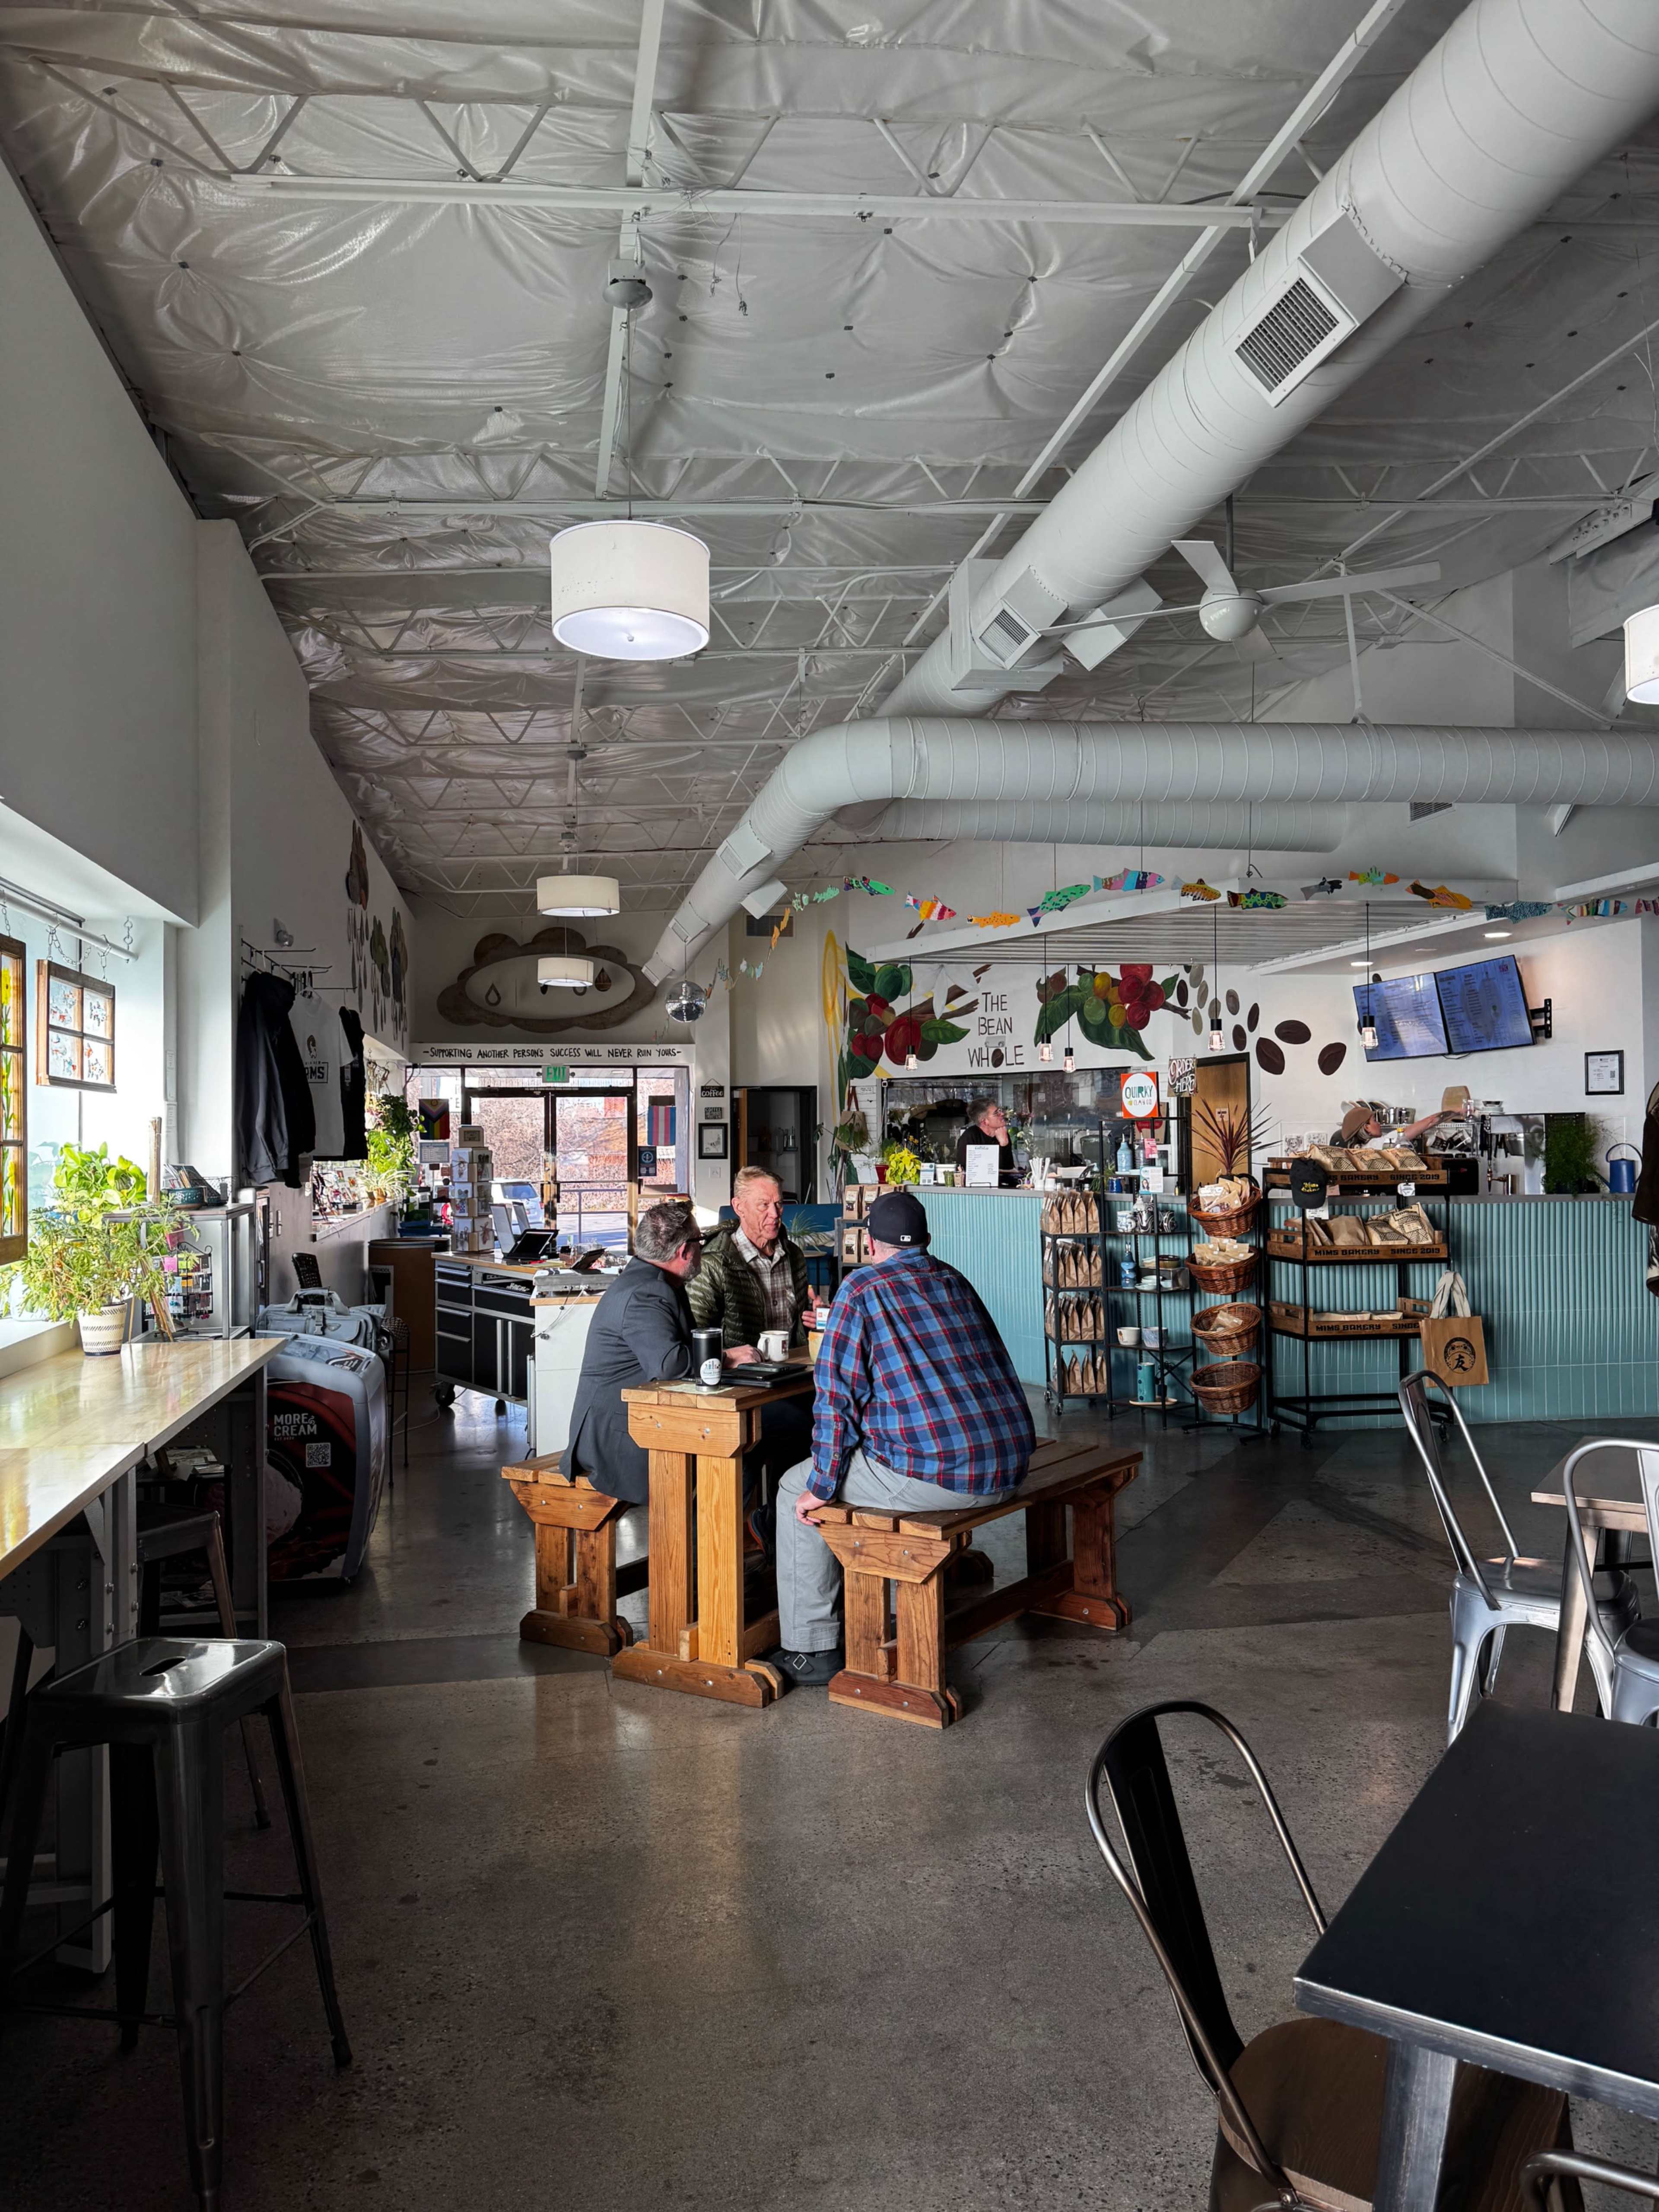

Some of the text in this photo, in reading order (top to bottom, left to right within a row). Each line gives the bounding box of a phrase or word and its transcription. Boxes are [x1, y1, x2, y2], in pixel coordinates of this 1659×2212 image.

[982, 992, 1007, 1012] THE
[979, 1016, 1012, 1036] BEAN
[477, 1048, 509, 1059] ANOTHER
[550, 1047, 581, 1057] SUCCESS
[585, 1048, 602, 1057] WILL
[607, 1048, 632, 1058] NEVER
[637, 1048, 652, 1058] RUIN
[968, 1045, 1024, 1068] WHOLE
[546, 1066, 566, 1082] EXIT
[1168, 1058, 1195, 1085] ORDER
[1125, 1085, 1153, 1099] QUIRKY
[273, 1424, 317, 1437] CREAM
